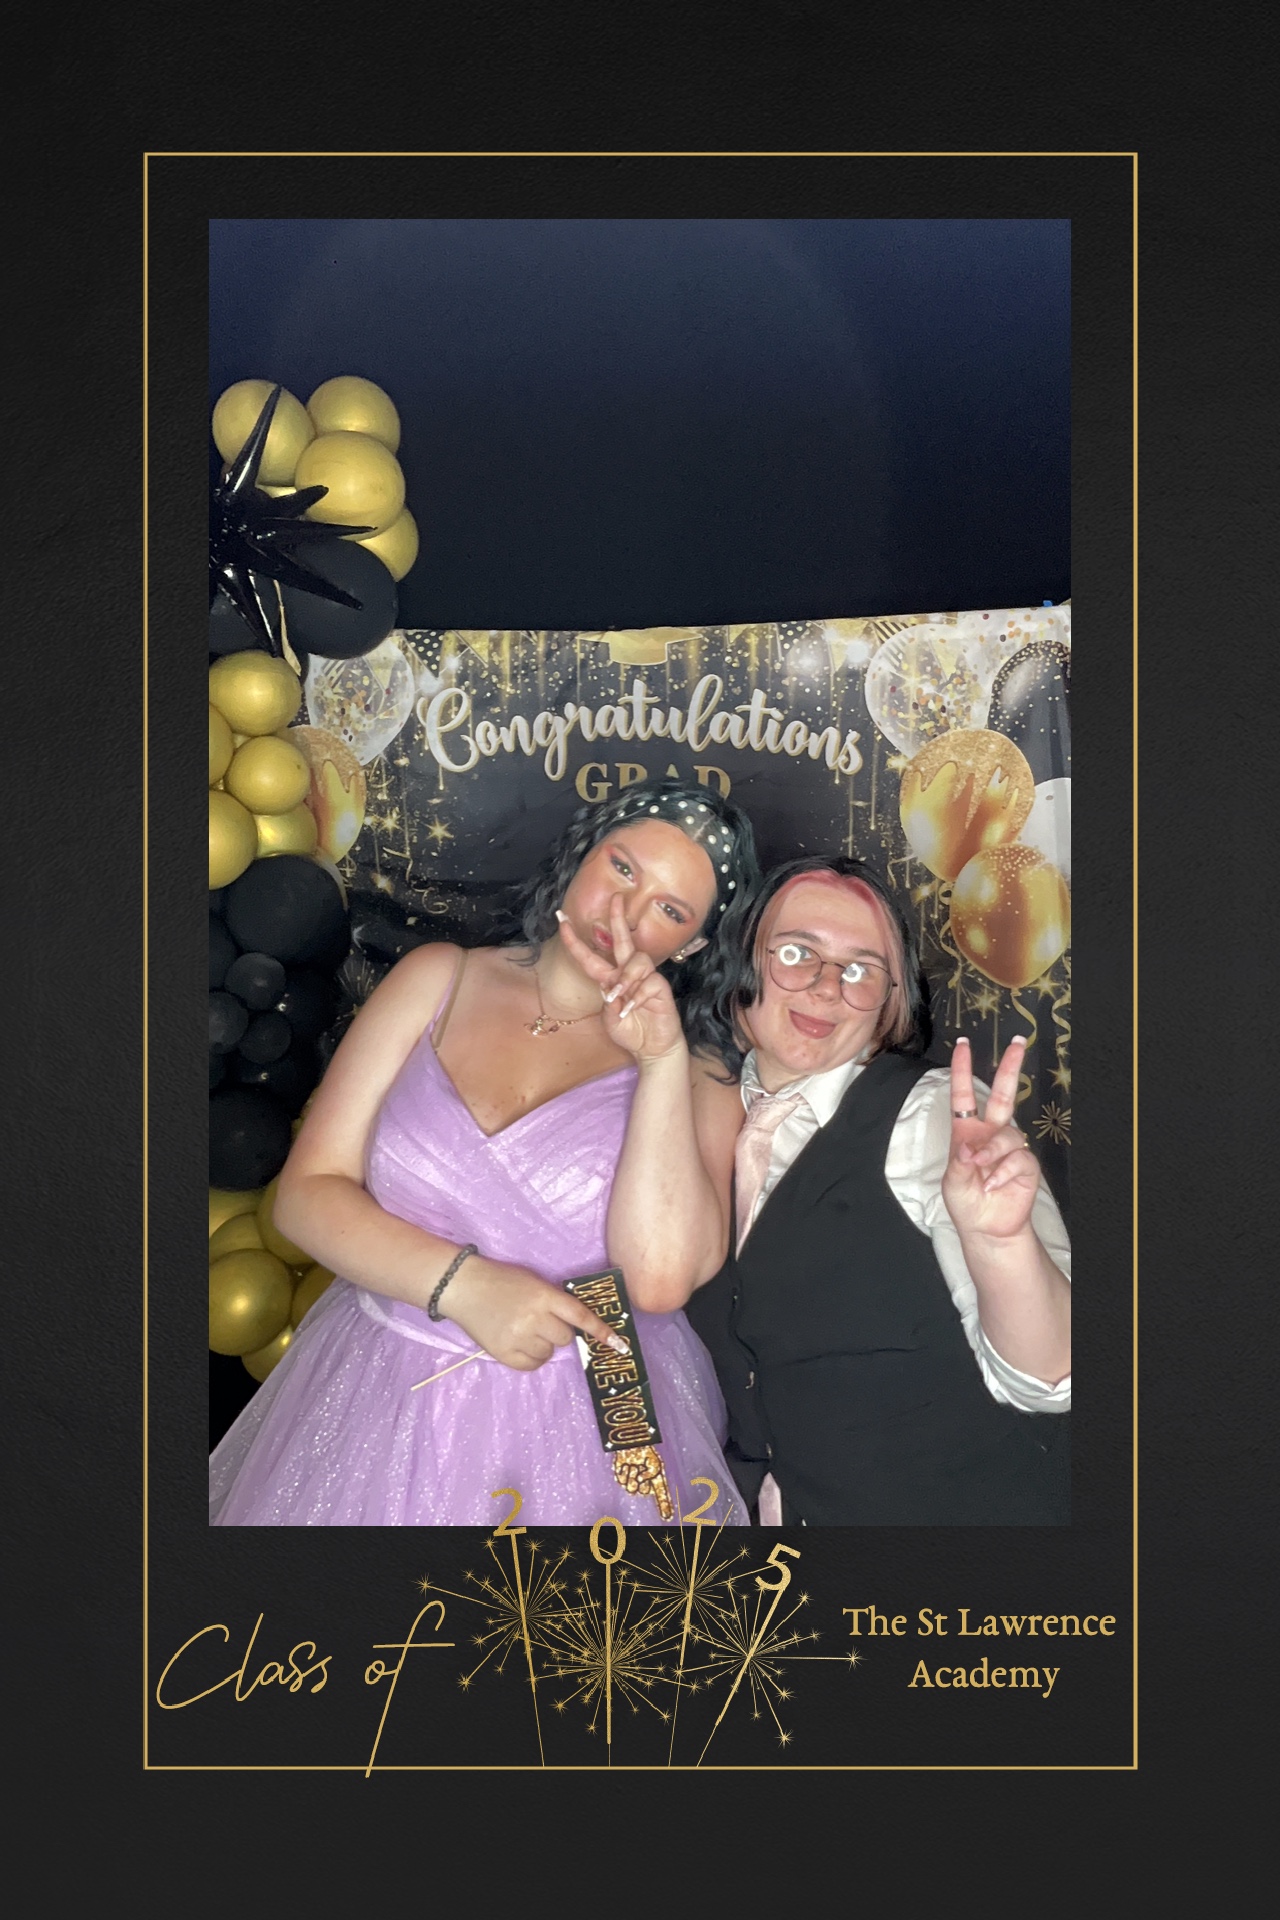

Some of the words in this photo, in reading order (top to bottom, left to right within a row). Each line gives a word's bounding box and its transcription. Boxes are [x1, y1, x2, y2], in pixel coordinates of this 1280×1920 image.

[416, 673, 864, 781] Congratulations
[574, 762, 731, 803] GRD
[601, 1385, 651, 1445] YOU
